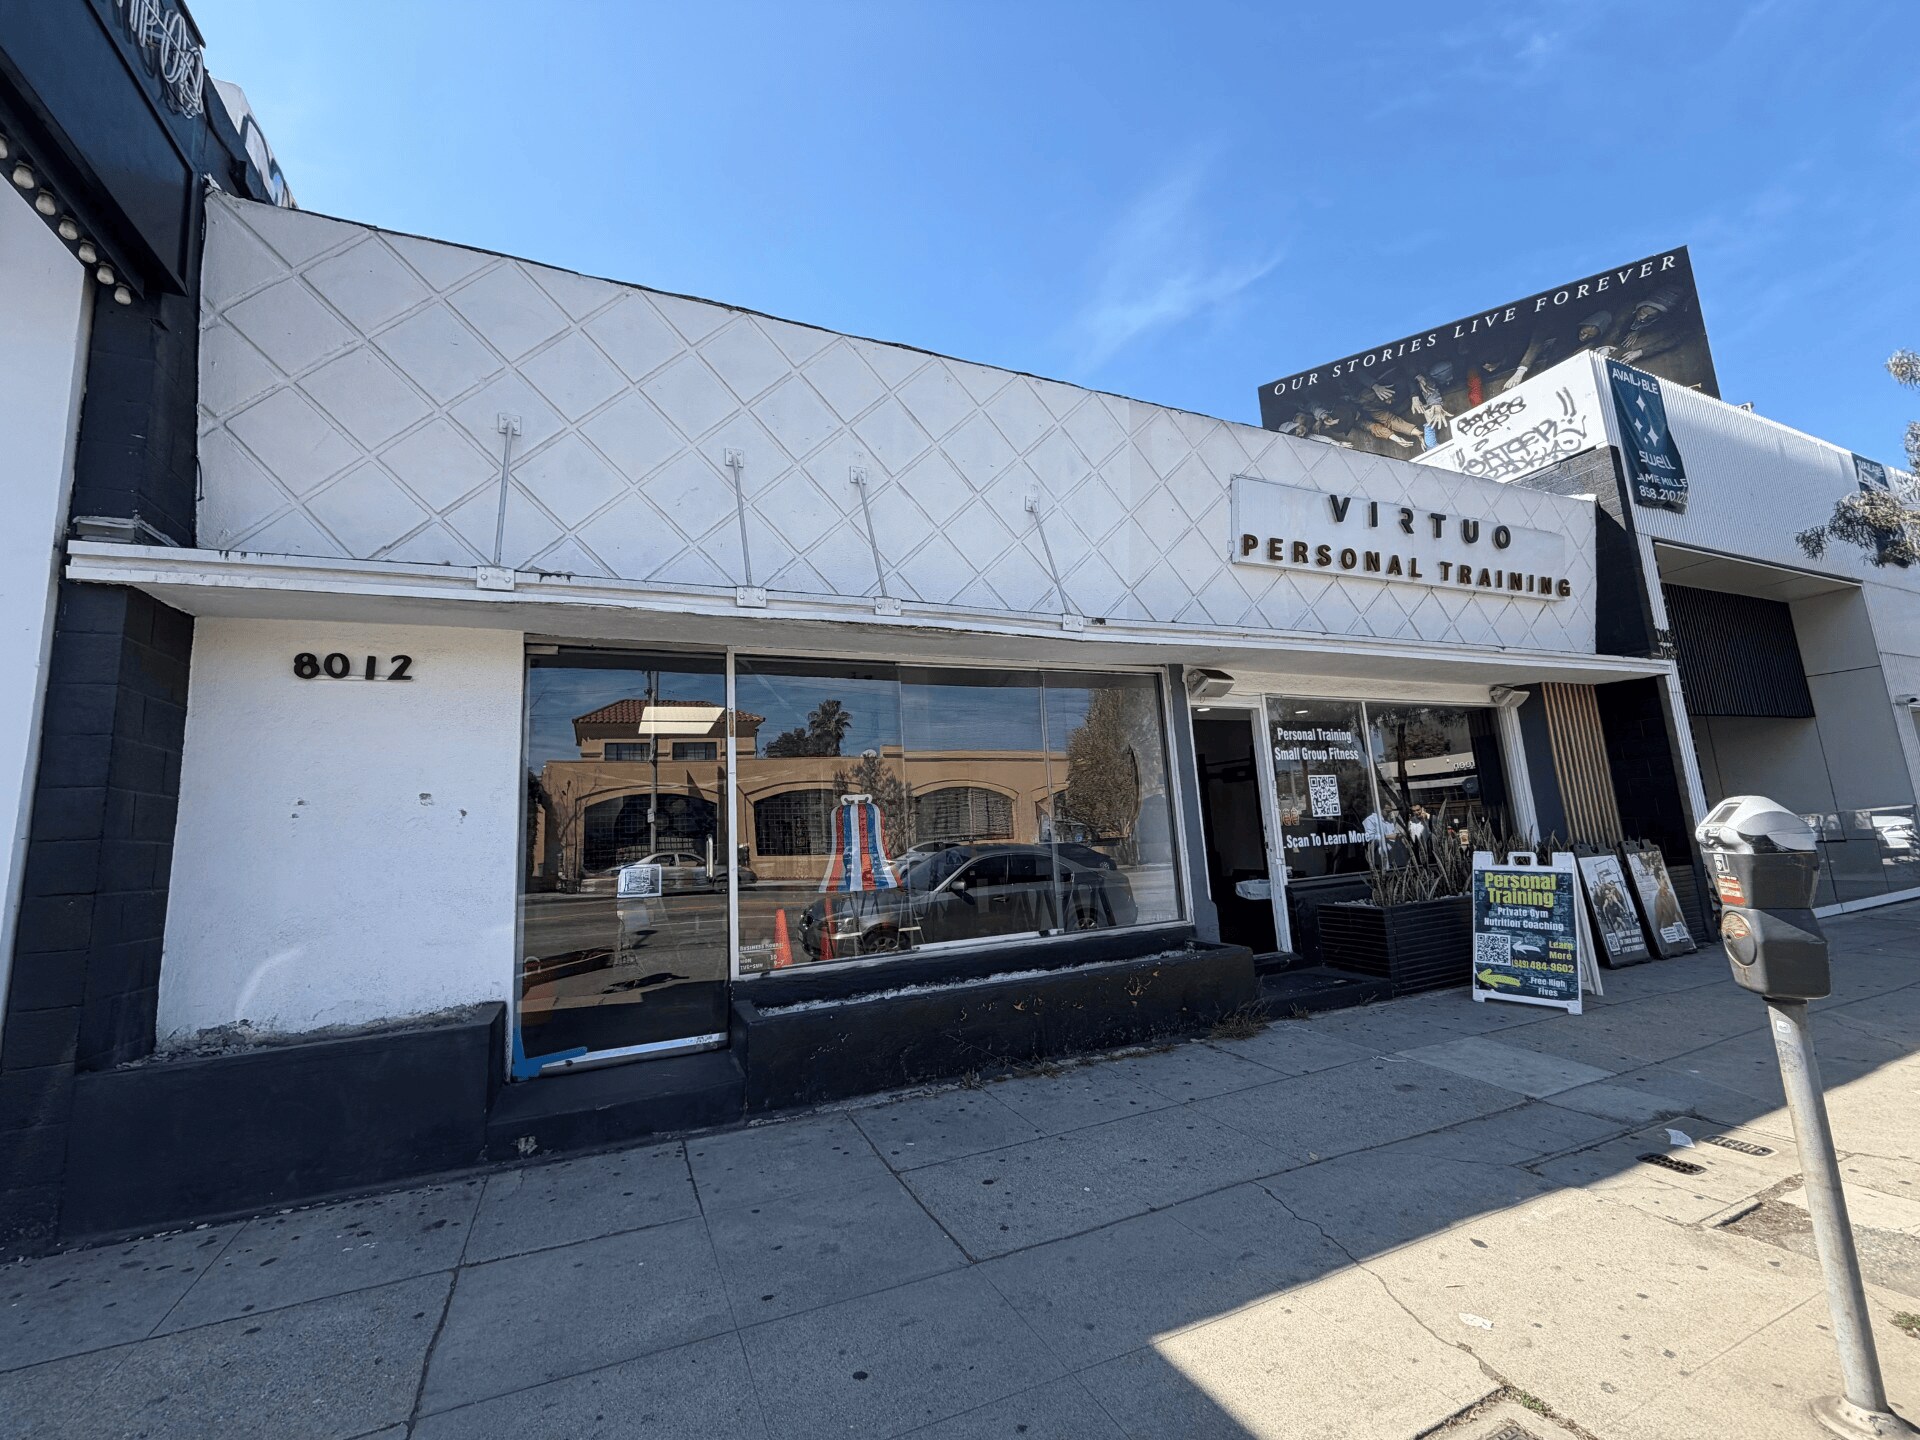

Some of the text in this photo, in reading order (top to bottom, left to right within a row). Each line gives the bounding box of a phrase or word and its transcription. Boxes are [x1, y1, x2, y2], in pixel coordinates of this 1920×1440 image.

[1274, 254, 1676, 396] OUR STORIES LIVE FOREVER
[1329, 494, 1512, 550] VIRTUO
[1241, 533, 1572, 598] PERSONAL TRAINING
[294, 652, 413, 681] 8012
[1277, 727, 1352, 744] Personal Training
[1274, 747, 1359, 762] Small Group Fitness
[1286, 830, 1371, 849] Scan To Learn More
[1484, 872, 1557, 891] Personal
[1487, 887, 1554, 908] Training
[1497, 906, 1549, 919] Private Gym
[1484, 917, 1564, 931] Nutrition Coaching
[1548, 940, 1574, 951] Learn
[1549, 951, 1572, 960] More
[1530, 960, 1574, 974] 484-9602
[1530, 976, 1547, 986] Free
[1538, 987, 1559, 997] Fives
